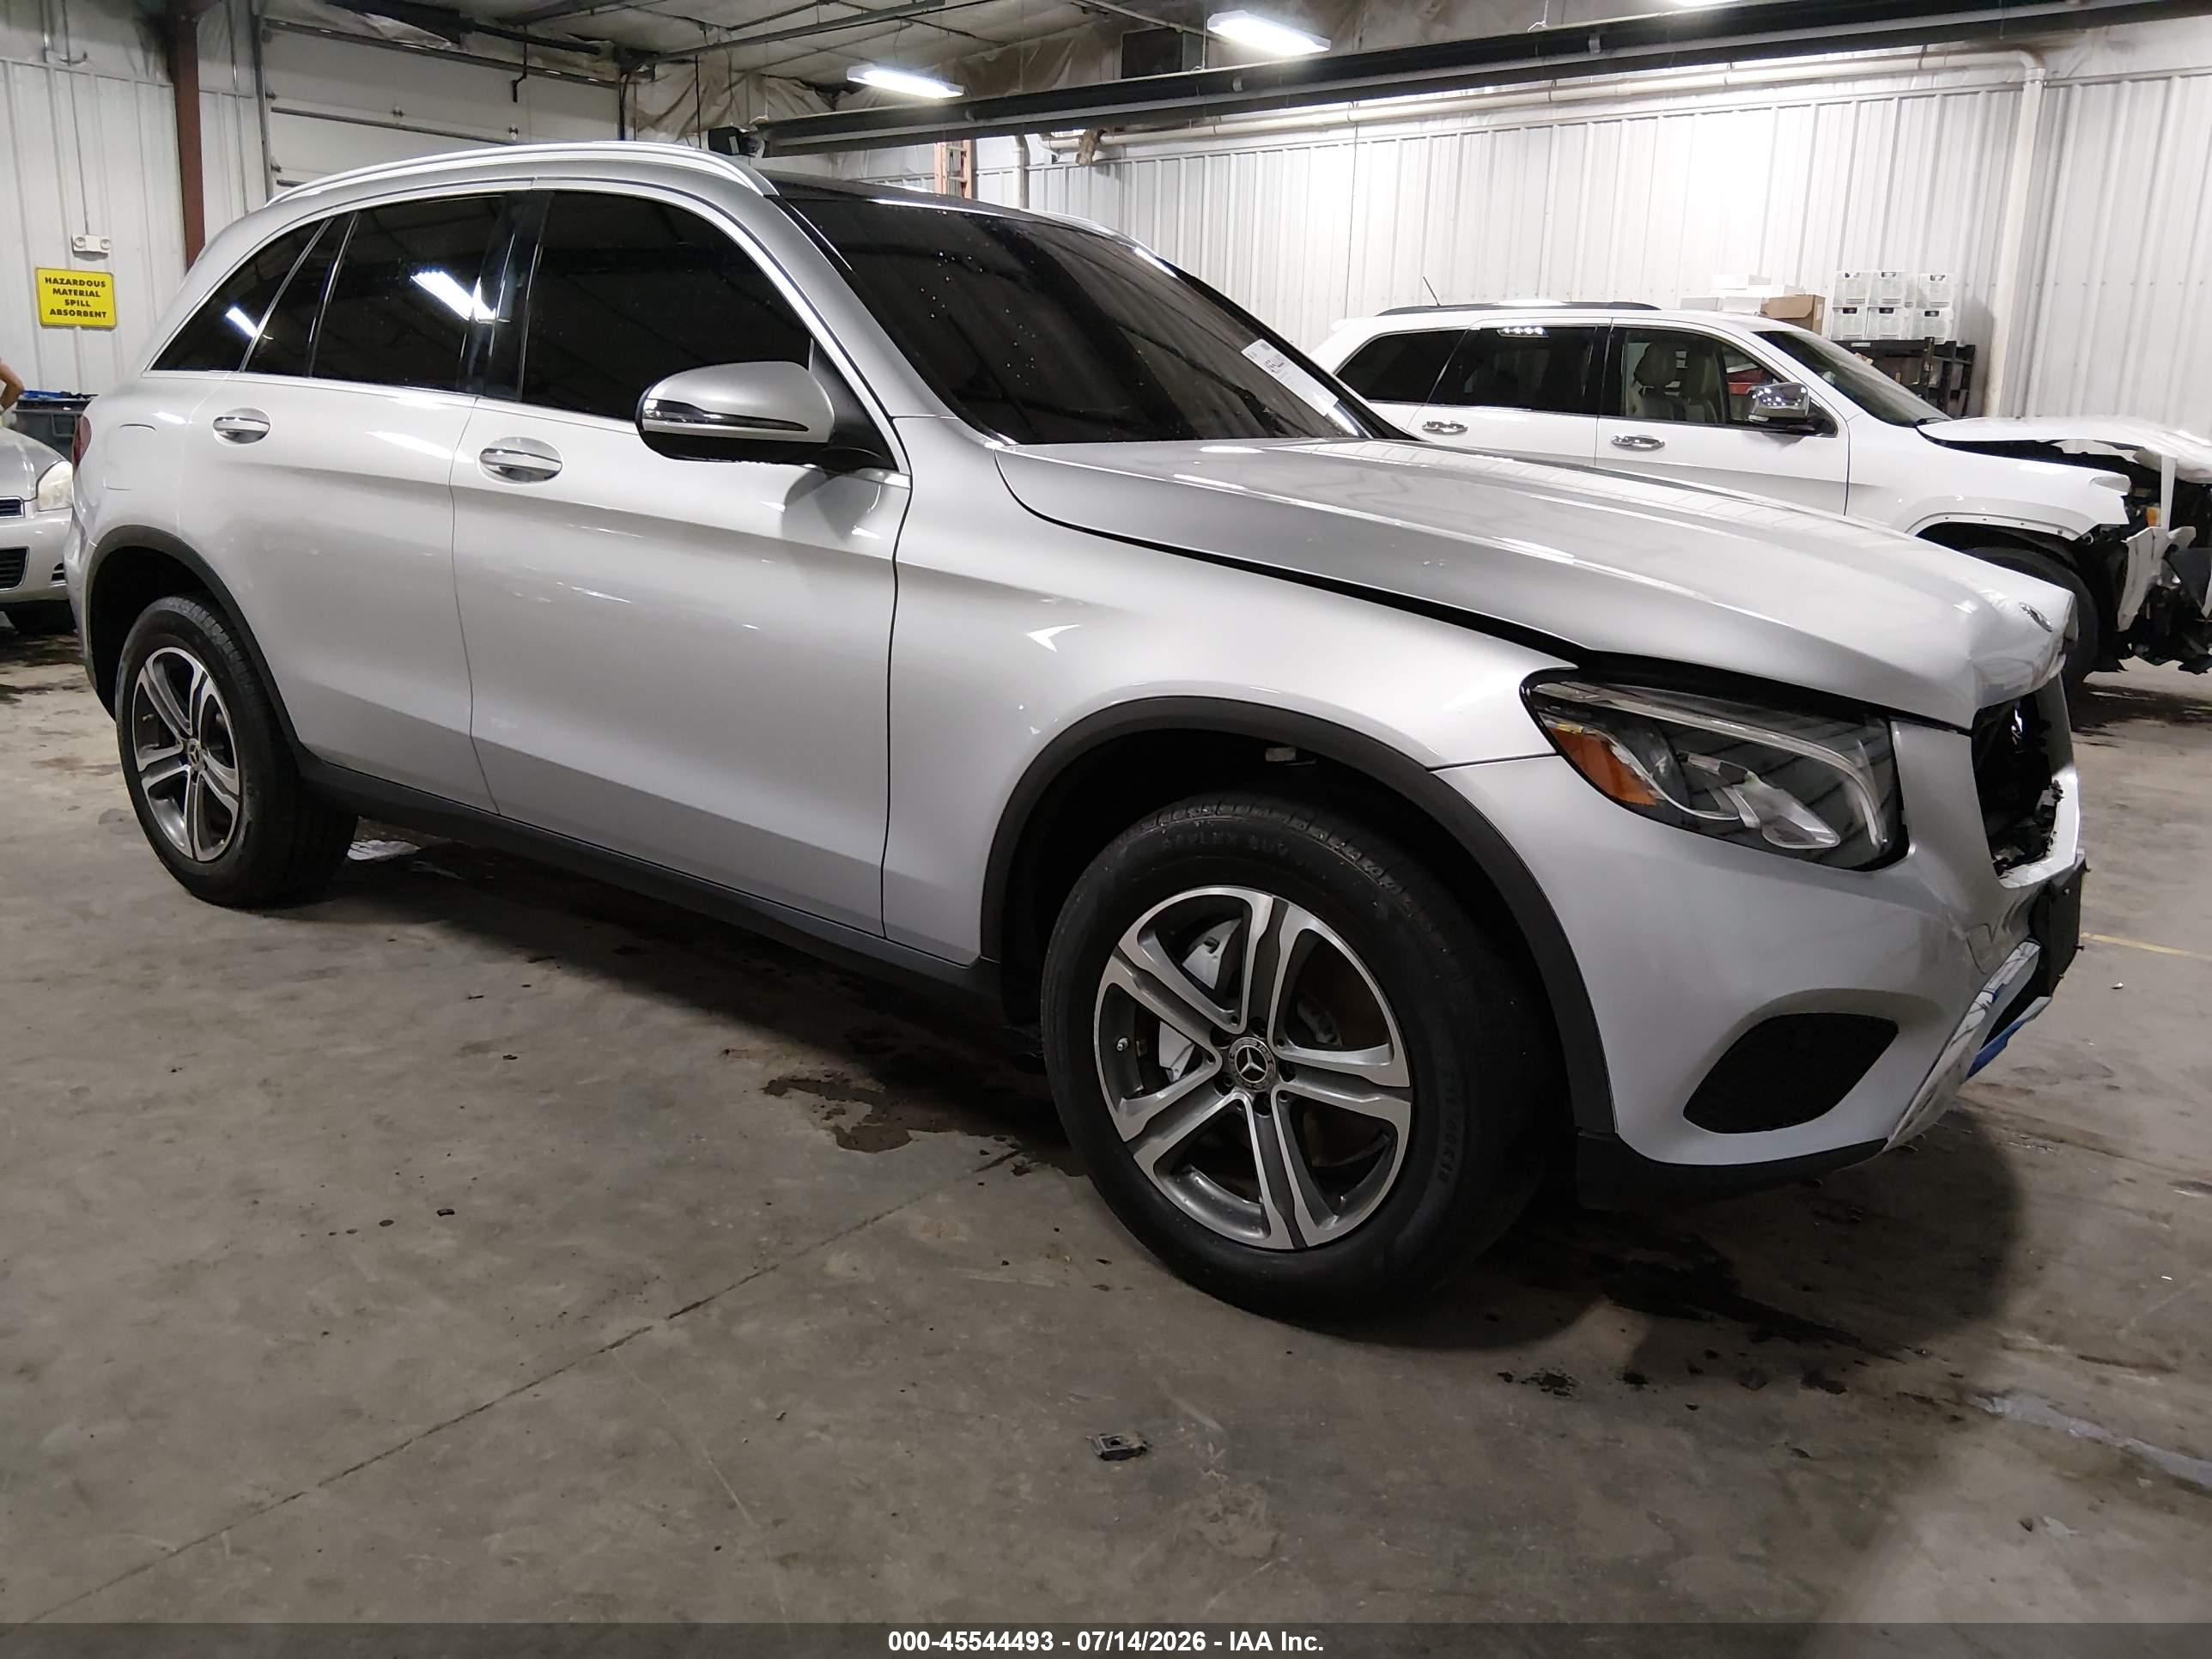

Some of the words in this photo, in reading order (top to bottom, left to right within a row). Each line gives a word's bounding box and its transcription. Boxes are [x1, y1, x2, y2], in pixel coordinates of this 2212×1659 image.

[45, 276, 106, 288] HAZARDOUS
[52, 288, 101, 298] MATERIAL
[64, 299, 91, 307] SPILL
[50, 308, 107, 319] ABSORBENT
